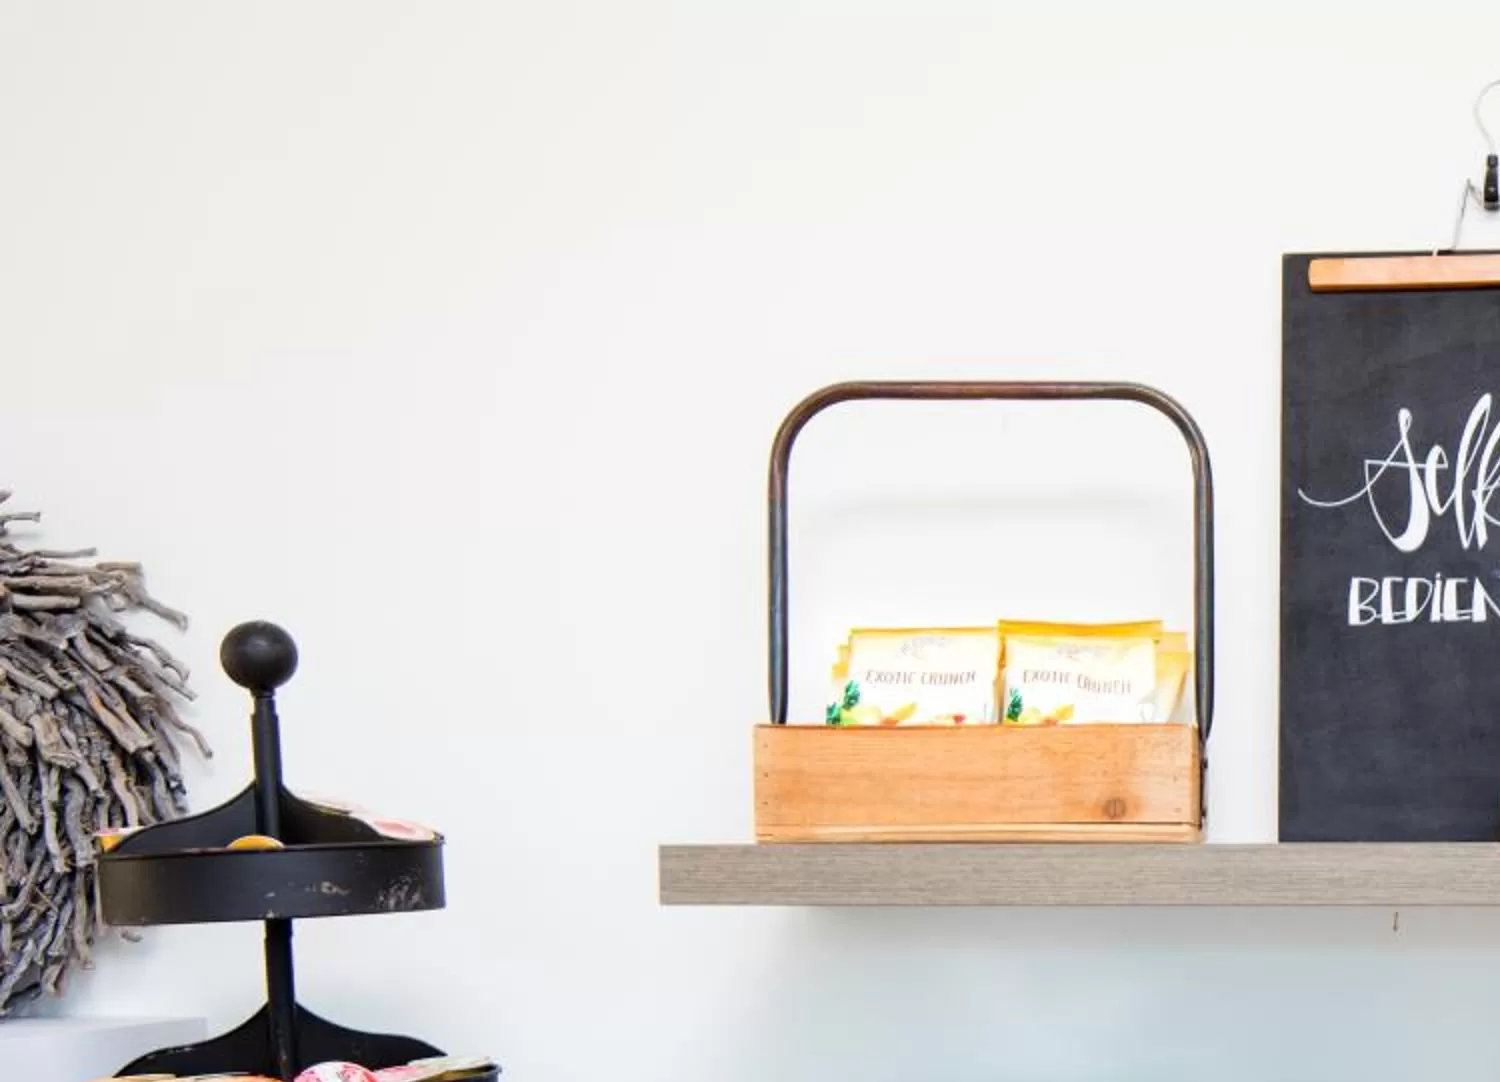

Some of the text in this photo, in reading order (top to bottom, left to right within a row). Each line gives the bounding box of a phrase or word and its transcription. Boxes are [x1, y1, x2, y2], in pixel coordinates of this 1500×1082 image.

[865, 668, 978, 687] EXOTIC CRUNCH
[1022, 668, 1073, 685] EXOTIC
